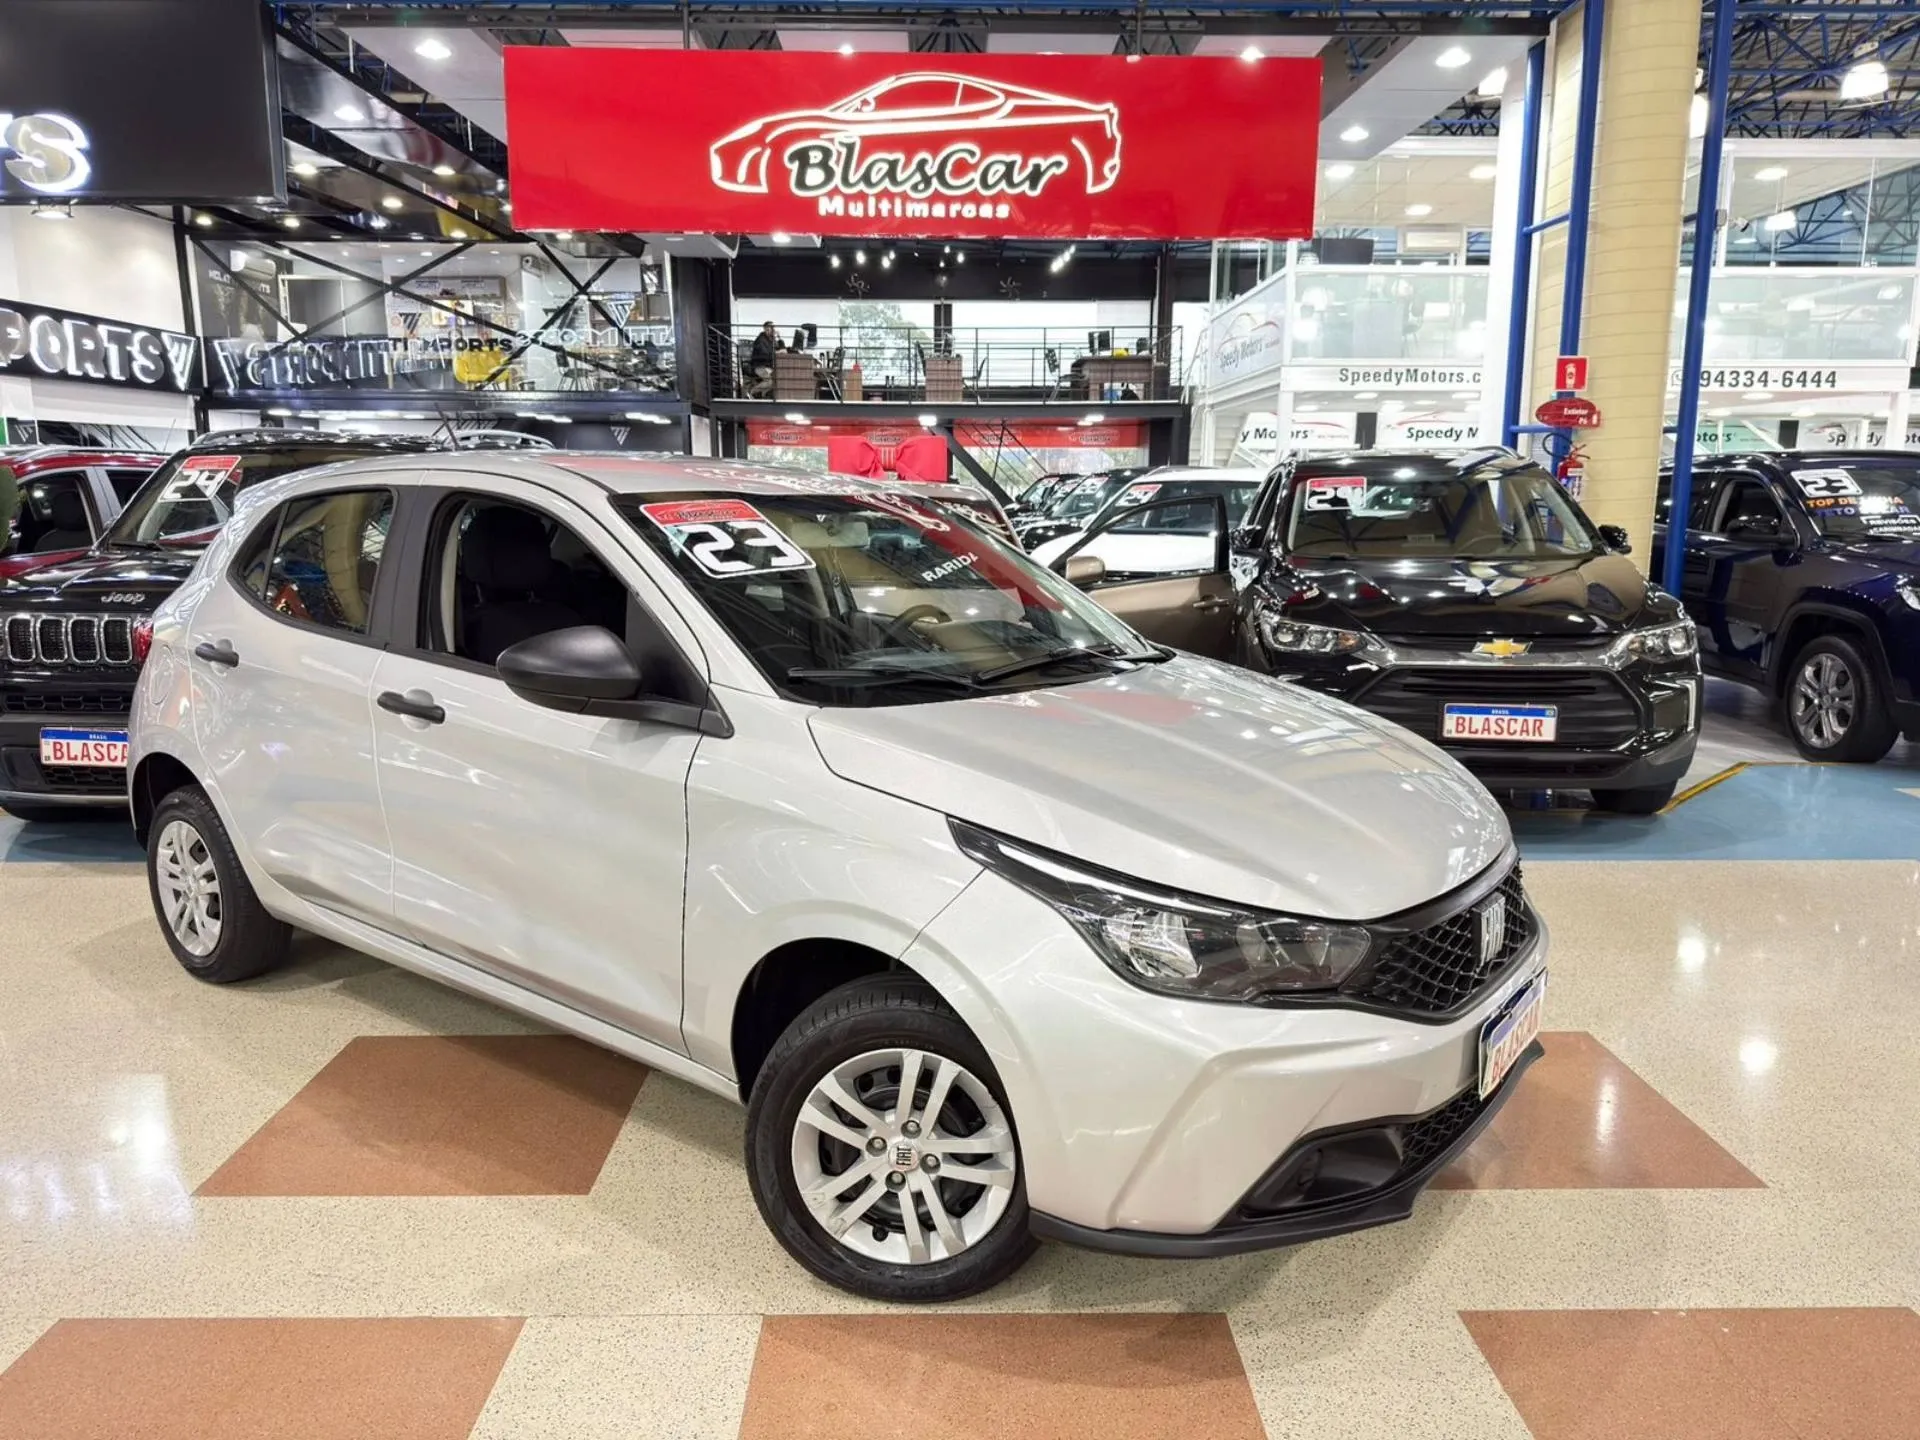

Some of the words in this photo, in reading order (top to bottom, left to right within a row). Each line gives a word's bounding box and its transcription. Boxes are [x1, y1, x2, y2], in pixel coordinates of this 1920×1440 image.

[785, 138, 1067, 197] BlasCar
[1700, 370, 1837, 388] 94334-6444
[1406, 427, 1463, 442] Speedy
[163, 470, 226, 499] 24
[1801, 477, 1852, 495] 23
[1806, 498, 1835, 508] TOP
[1838, 497, 1858, 505] DE
[1816, 506, 1856, 517] TETO
[678, 521, 805, 573] 23
[101, 592, 146, 605] Jeep
[1455, 716, 1544, 737] BLASCAR
[895, 1145, 912, 1166] FIAT
